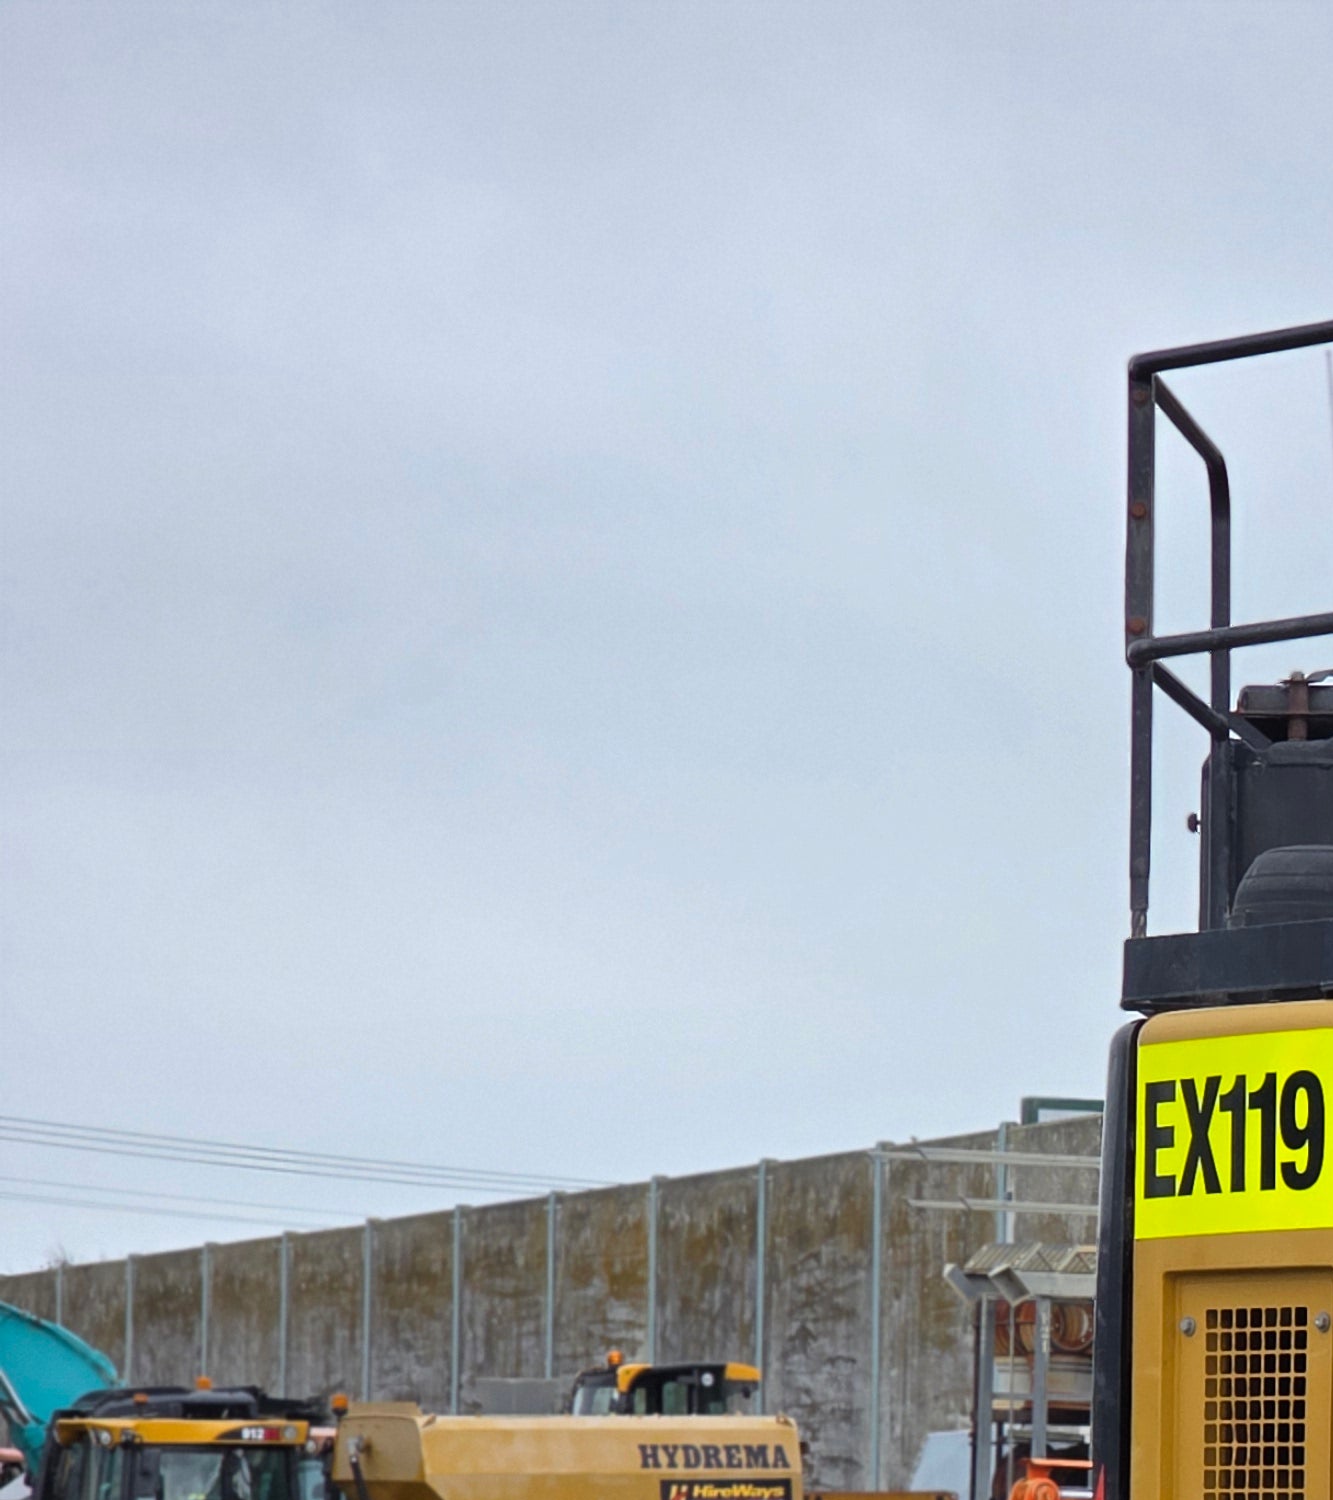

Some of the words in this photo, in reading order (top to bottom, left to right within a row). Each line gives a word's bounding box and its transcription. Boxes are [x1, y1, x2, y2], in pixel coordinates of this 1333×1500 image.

[1144, 1070, 1326, 1199] EX119
[638, 1444, 790, 1469] HYDREMA
[692, 1483, 785, 1499] HireWays
